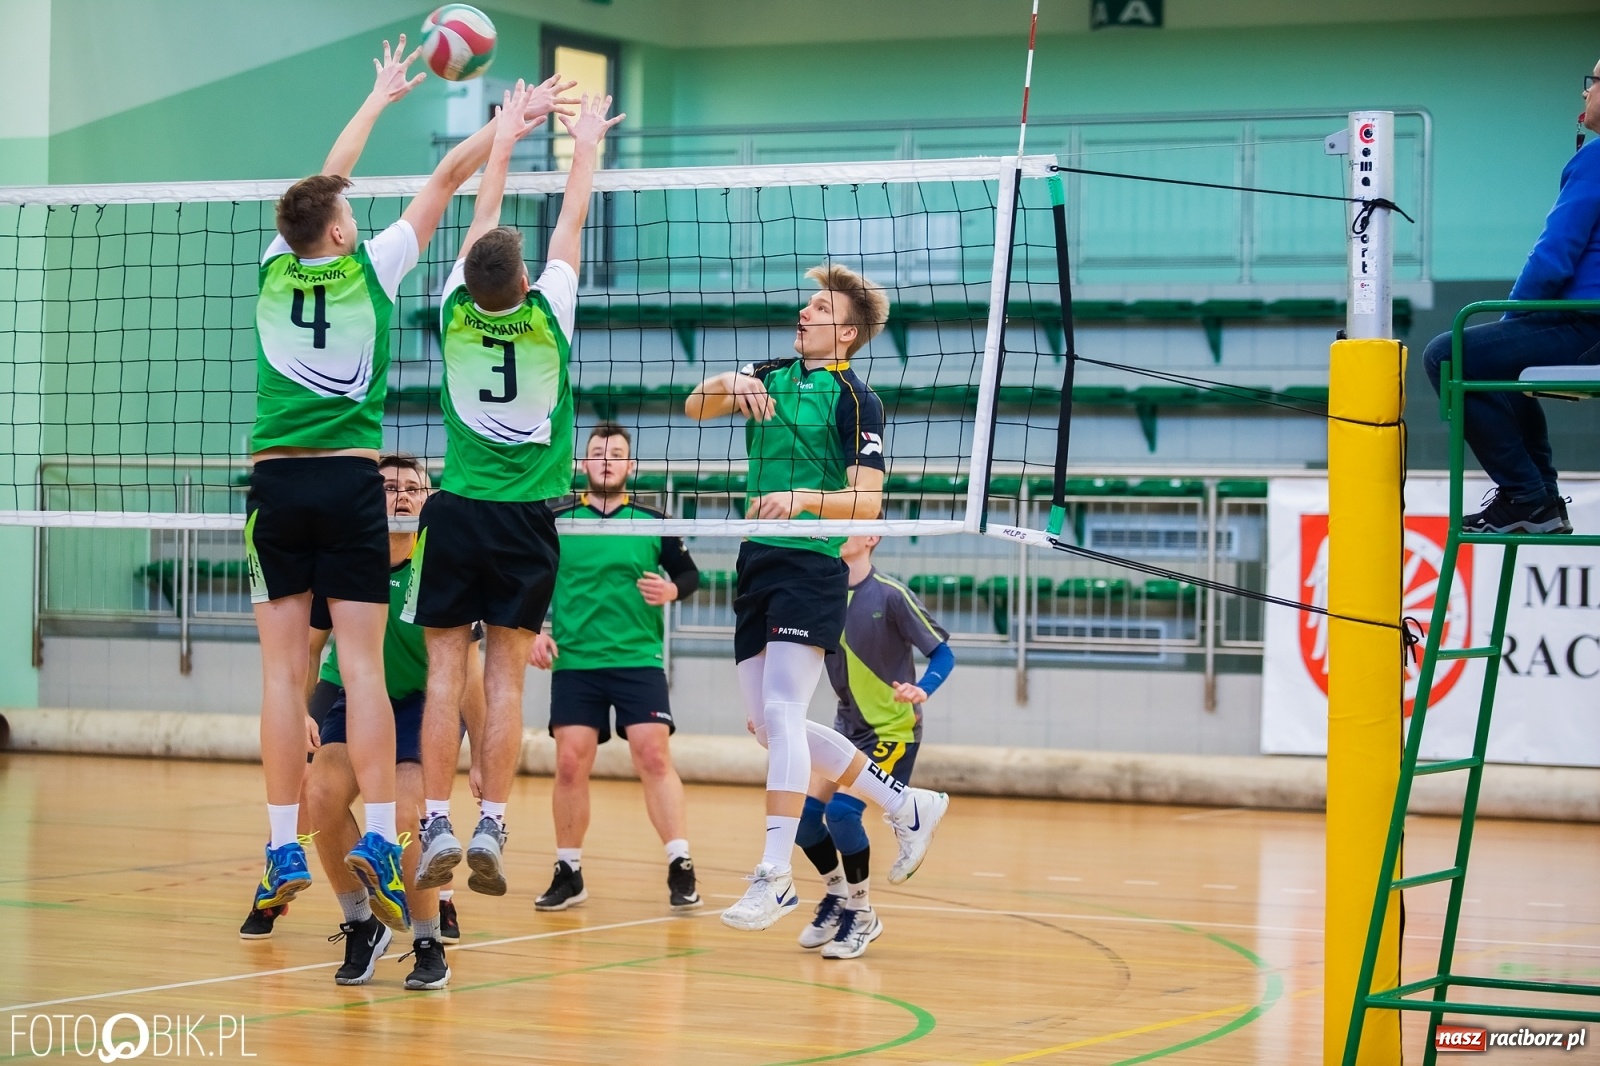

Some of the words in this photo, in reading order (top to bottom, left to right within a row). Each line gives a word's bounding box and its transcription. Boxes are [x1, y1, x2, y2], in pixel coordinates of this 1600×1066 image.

[1119, 0, 1156, 24] A
[290, 284, 331, 350] 4
[464, 313, 535, 336] MECHANIK
[479, 335, 518, 404] 3
[1523, 563, 1600, 609] MI
[778, 627, 809, 638] PATRICK
